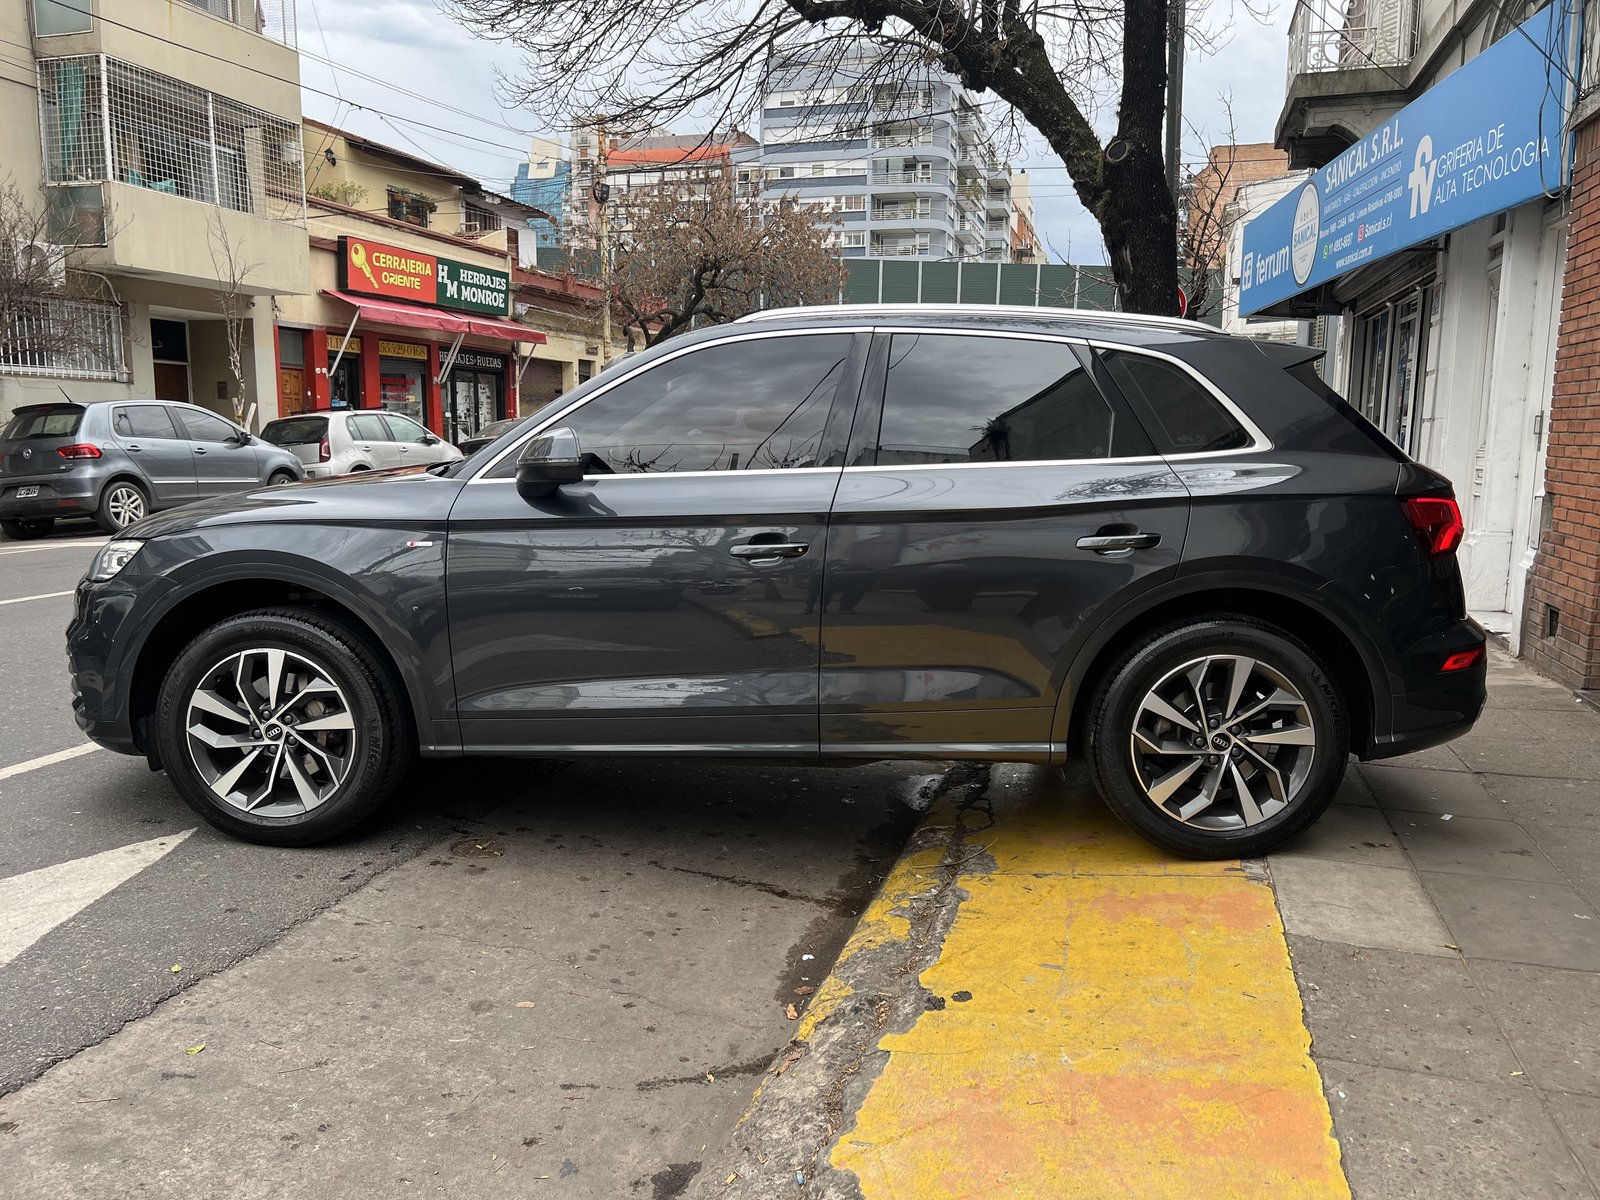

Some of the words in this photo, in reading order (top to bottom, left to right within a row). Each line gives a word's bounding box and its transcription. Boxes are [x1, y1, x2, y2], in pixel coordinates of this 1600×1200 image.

[1325, 141, 1368, 194] SANICAL
[1370, 119, 1404, 164] S.R.L.
[1437, 136, 1484, 178] GRIFERIA
[1486, 123, 1505, 154] DE
[1433, 178, 1457, 207] ALTA
[1462, 135, 1550, 194] TECNOLOGIA
[372, 252, 433, 277] CERRAJERIA
[381, 271, 421, 290] ORIENTE
[459, 268, 507, 291] HERRAJES
[1255, 244, 1290, 286] ferrum
[461, 285, 505, 308] MONROE
